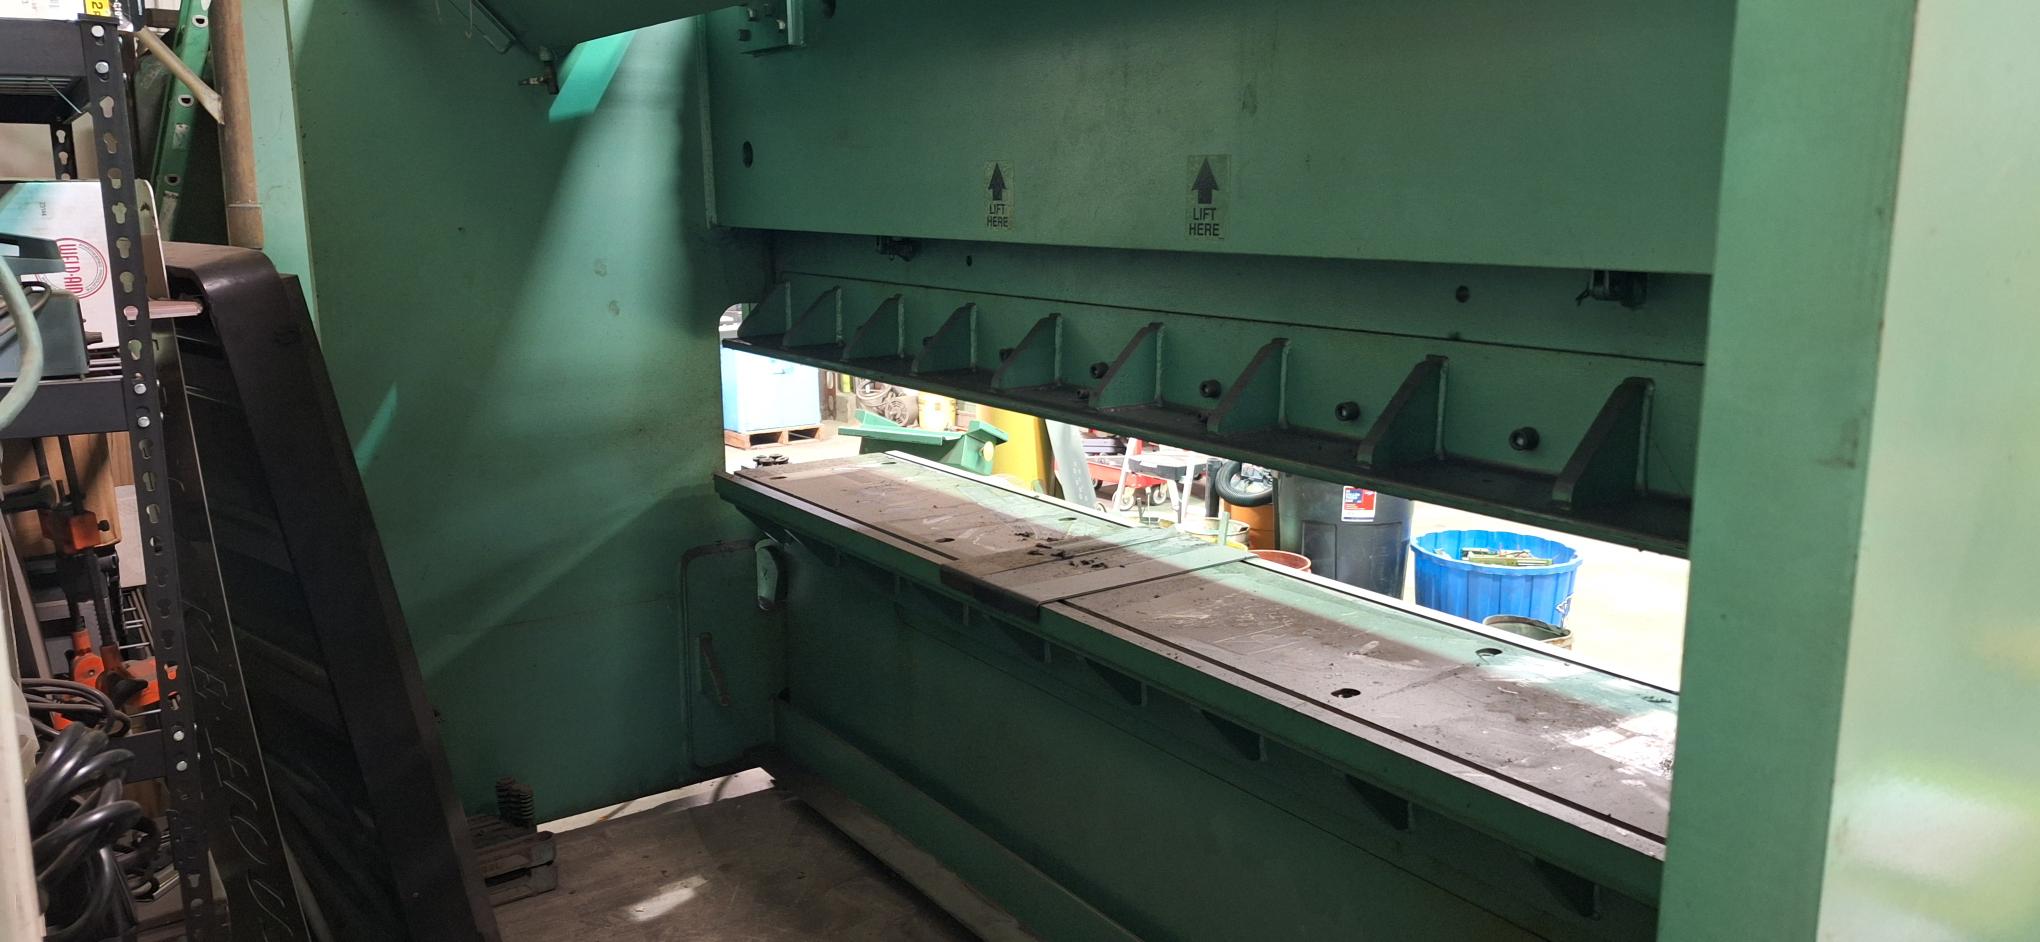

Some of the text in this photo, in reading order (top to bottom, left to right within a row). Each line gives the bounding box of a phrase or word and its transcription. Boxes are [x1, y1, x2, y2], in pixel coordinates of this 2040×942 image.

[989, 204, 1006, 215] LIFT
[1193, 207, 1217, 221] LIFT
[987, 217, 1009, 228] HERE
[1189, 223, 1220, 237] HERE
